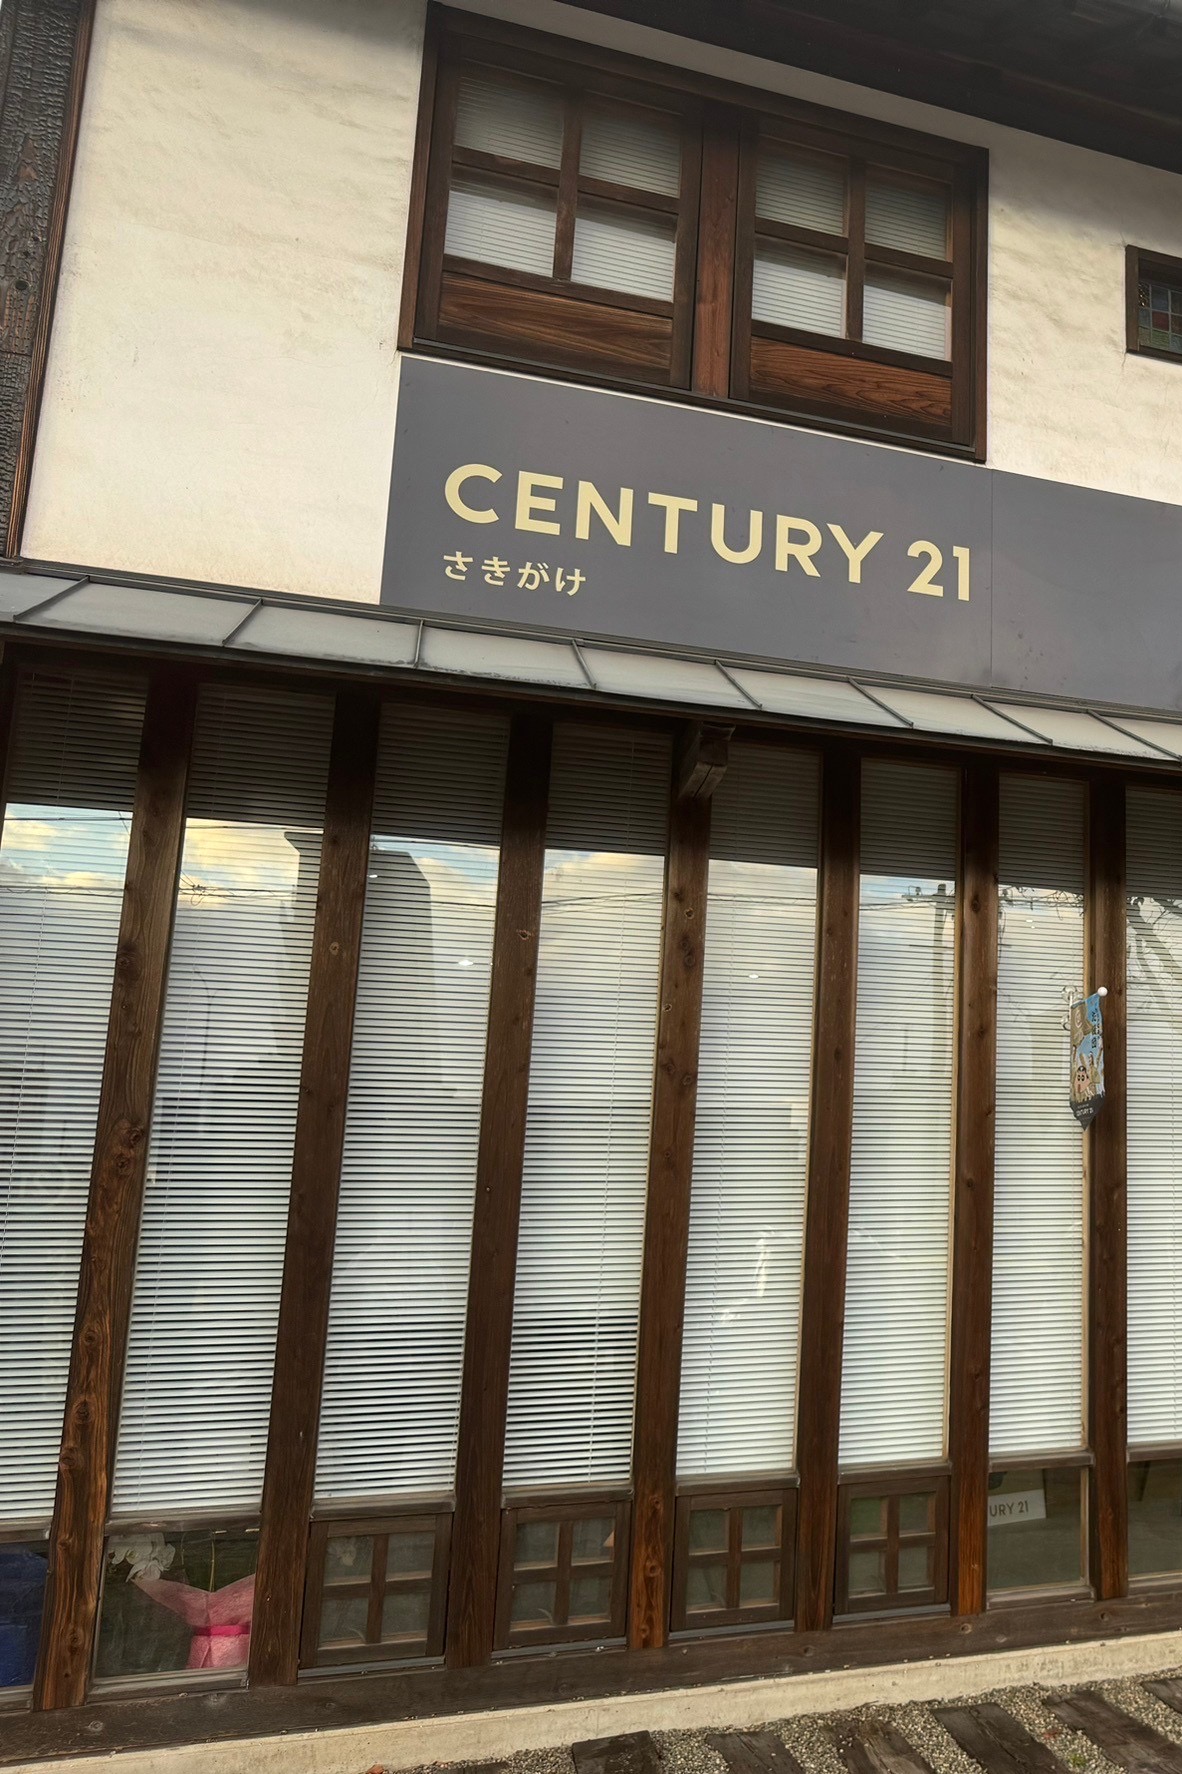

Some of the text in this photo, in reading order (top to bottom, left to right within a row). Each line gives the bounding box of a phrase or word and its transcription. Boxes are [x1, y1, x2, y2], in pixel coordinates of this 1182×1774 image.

[444, 463, 970, 601] CENTURY 21
[443, 551, 586, 596] さきがけ
[1018, 1500, 1029, 1514] 21
